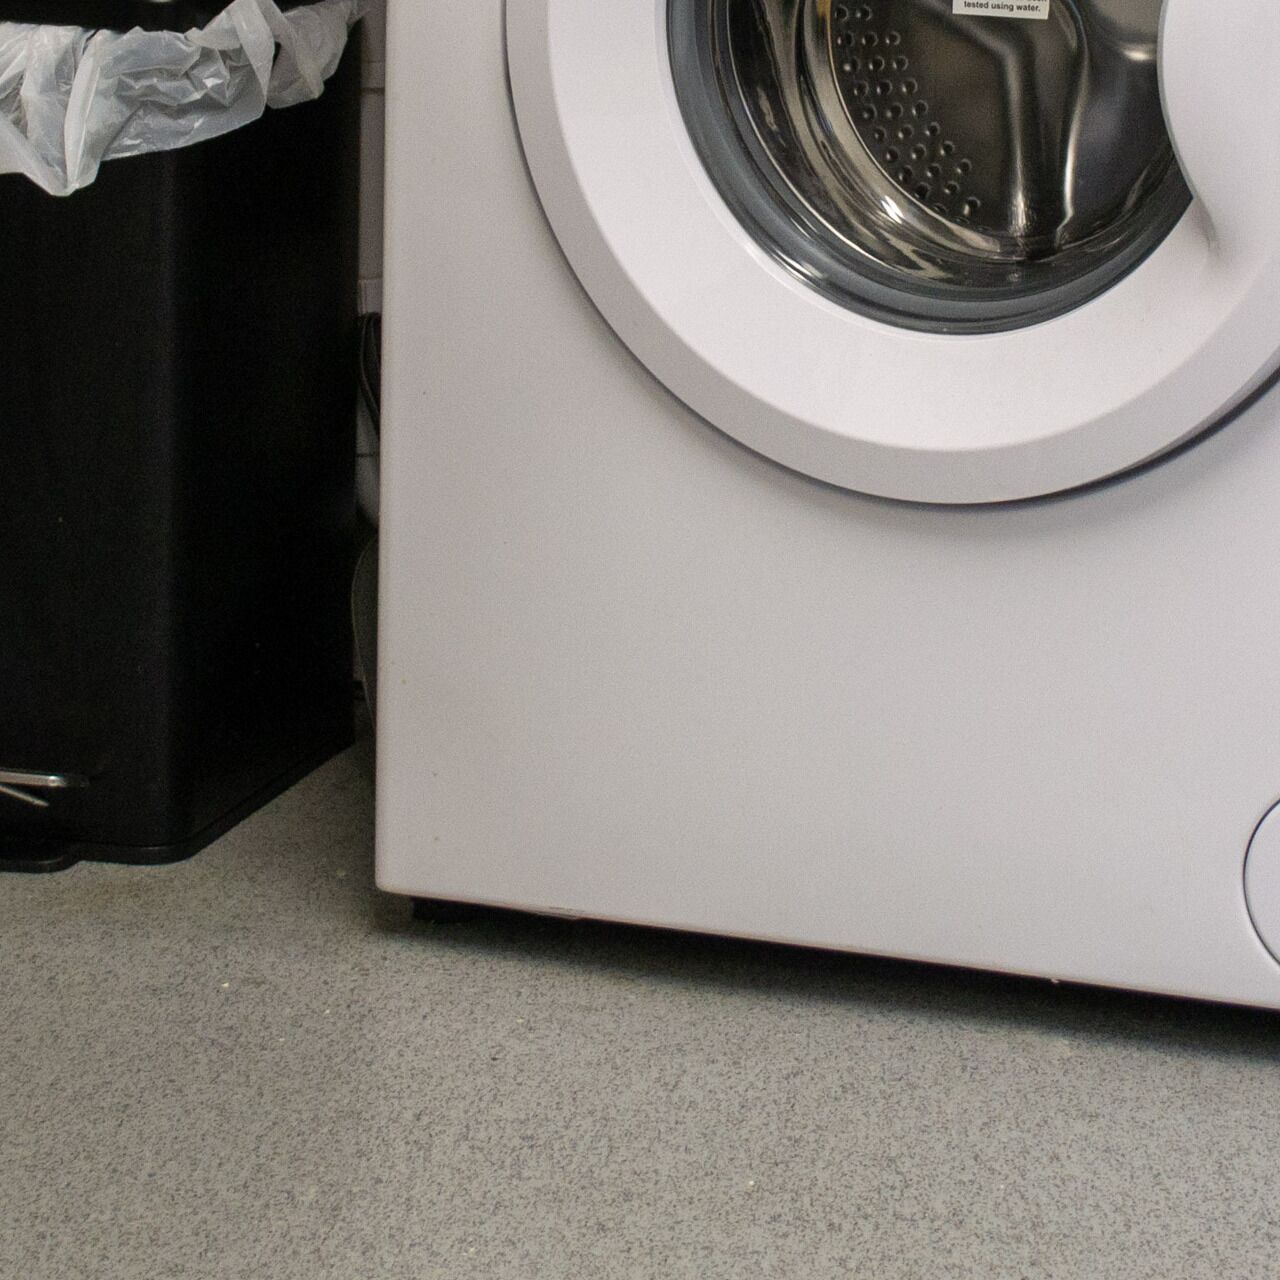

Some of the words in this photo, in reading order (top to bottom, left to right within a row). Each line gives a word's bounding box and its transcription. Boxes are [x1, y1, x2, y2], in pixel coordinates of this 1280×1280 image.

[963, 0, 989, 9] tested
[991, 2, 1014, 12] using
[1016, 3, 1041, 12] water.
